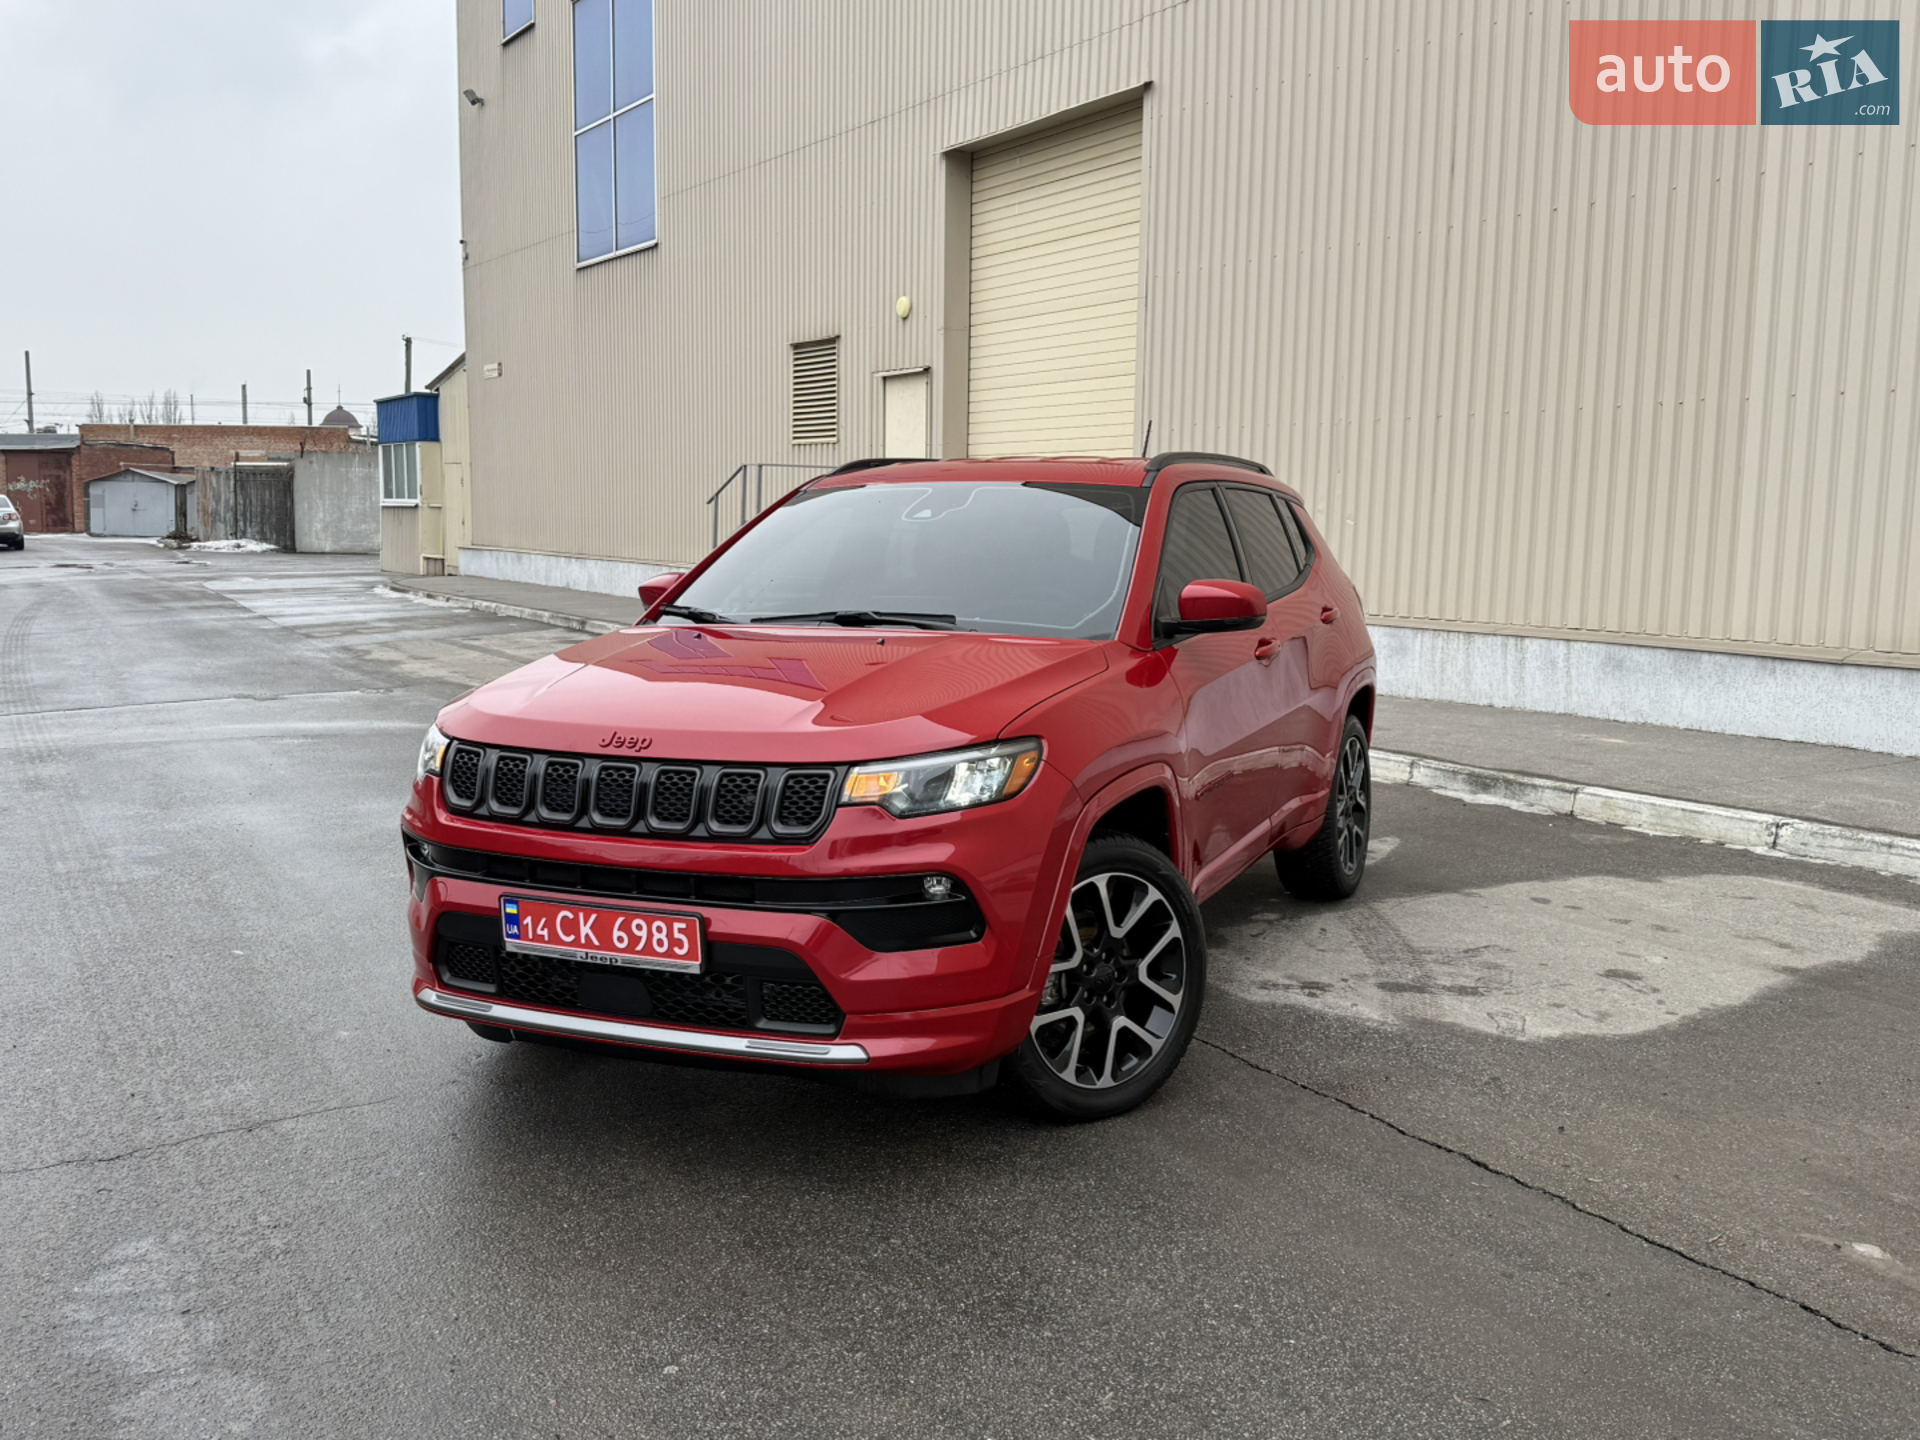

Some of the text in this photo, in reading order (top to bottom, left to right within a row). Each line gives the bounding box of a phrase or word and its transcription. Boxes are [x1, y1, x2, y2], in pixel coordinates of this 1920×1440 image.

[598, 730, 653, 753] Jeep
[506, 923, 520, 936] UA
[523, 910, 690, 956] 14 CK 6985
[579, 951, 619, 966] Jeep
